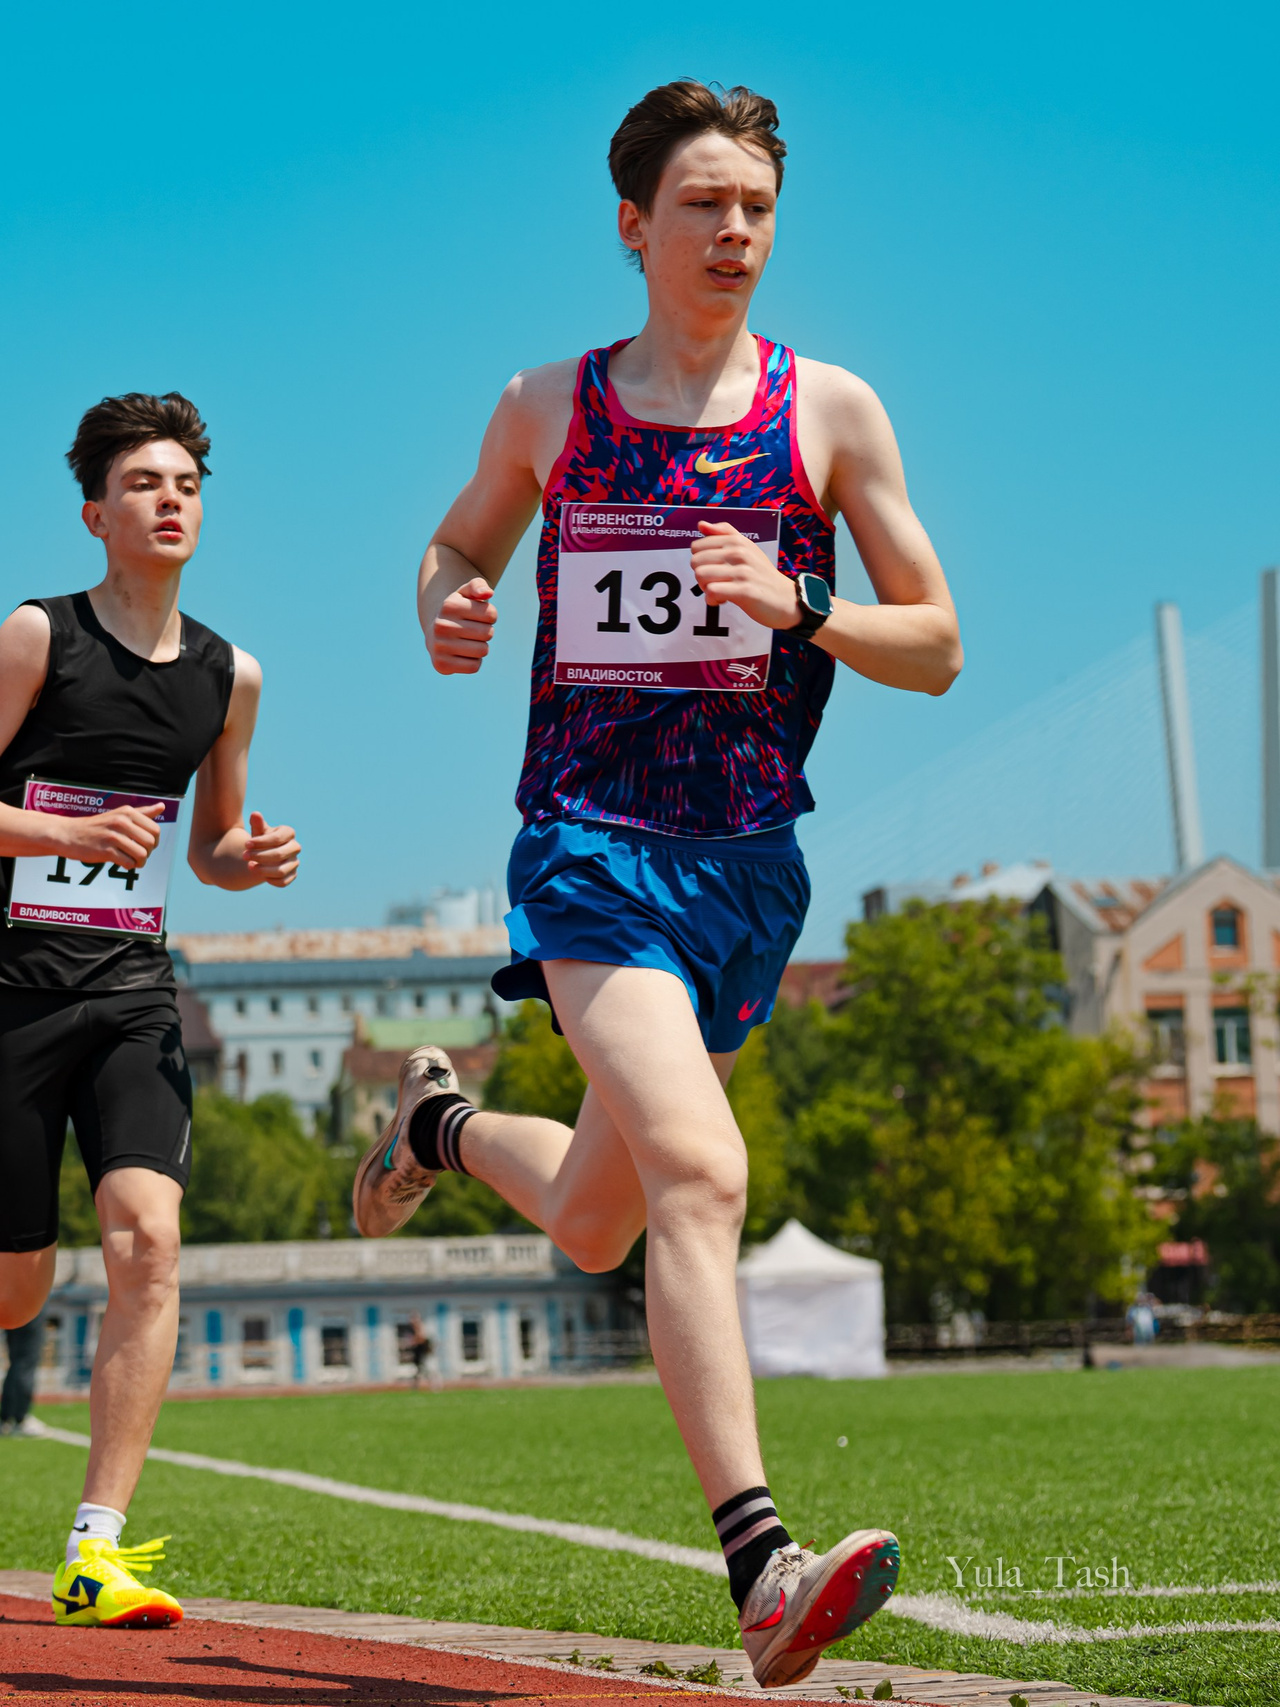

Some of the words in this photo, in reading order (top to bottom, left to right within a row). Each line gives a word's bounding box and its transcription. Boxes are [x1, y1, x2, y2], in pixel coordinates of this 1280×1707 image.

[571, 512, 665, 527] ПЕРВЕНСТВО
[571, 526, 657, 536] ДАЛЬНЕВОСТОЧНОГО
[658, 529, 706, 538] ФЕДЕРАЛЬ
[594, 570, 730, 637] 131
[567, 668, 663, 683] ВЛАДИВОСТОК
[36, 789, 104, 807] ПЕРВЕНСТВО
[20, 906, 90, 923] ВЛАДИВОСТОК
